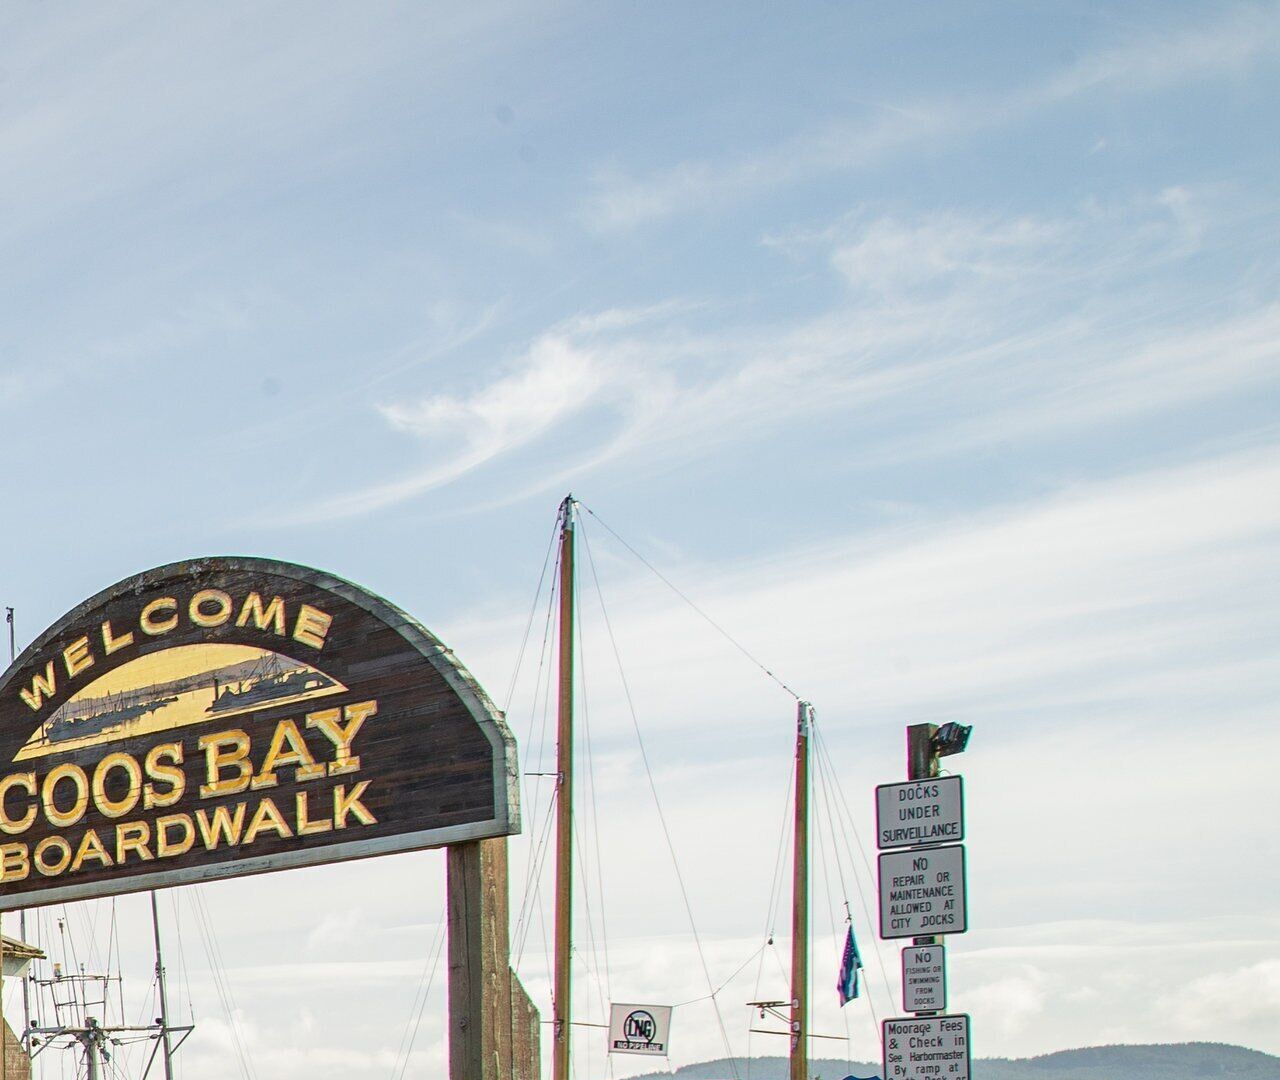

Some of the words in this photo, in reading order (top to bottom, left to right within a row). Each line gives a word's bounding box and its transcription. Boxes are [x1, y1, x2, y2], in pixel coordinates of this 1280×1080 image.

[18, 589, 334, 713] WELCOME
[197, 700, 379, 800] BAY
[899, 785, 939, 802] DOCKS
[899, 804, 940, 821] UNDER
[882, 822, 959, 842] SURVEILLANCE
[913, 857, 928, 871] NO
[892, 874, 925, 887] REPAIR
[936, 872, 950, 884] OR
[890, 885, 954, 901] MAINTENANCE
[890, 902, 932, 915] ALLOWED
[944, 899, 955, 911] AT
[891, 917, 911, 930] CITY
[922, 914, 954, 927] DOCKS
[915, 952, 932, 964] NO
[908, 976, 940, 985] SWIMMING
[915, 987, 933, 995] FROM
[914, 997, 935, 1005] DOCKS
[628, 1019, 652, 1037] LNG
[889, 1023, 931, 1036] Moorage
[940, 1021, 963, 1032] Fees
[629, 1042, 661, 1051] PIPELINE
[889, 1038, 899, 1049] &
[909, 1036, 943, 1048] Check
[954, 1035, 965, 1046] in
[888, 1053, 902, 1063] See
[909, 1051, 965, 1062] Harbormaster
[895, 1065, 906, 1076] By
[915, 1065, 940, 1076] ramp
[949, 1063, 959, 1072] at
